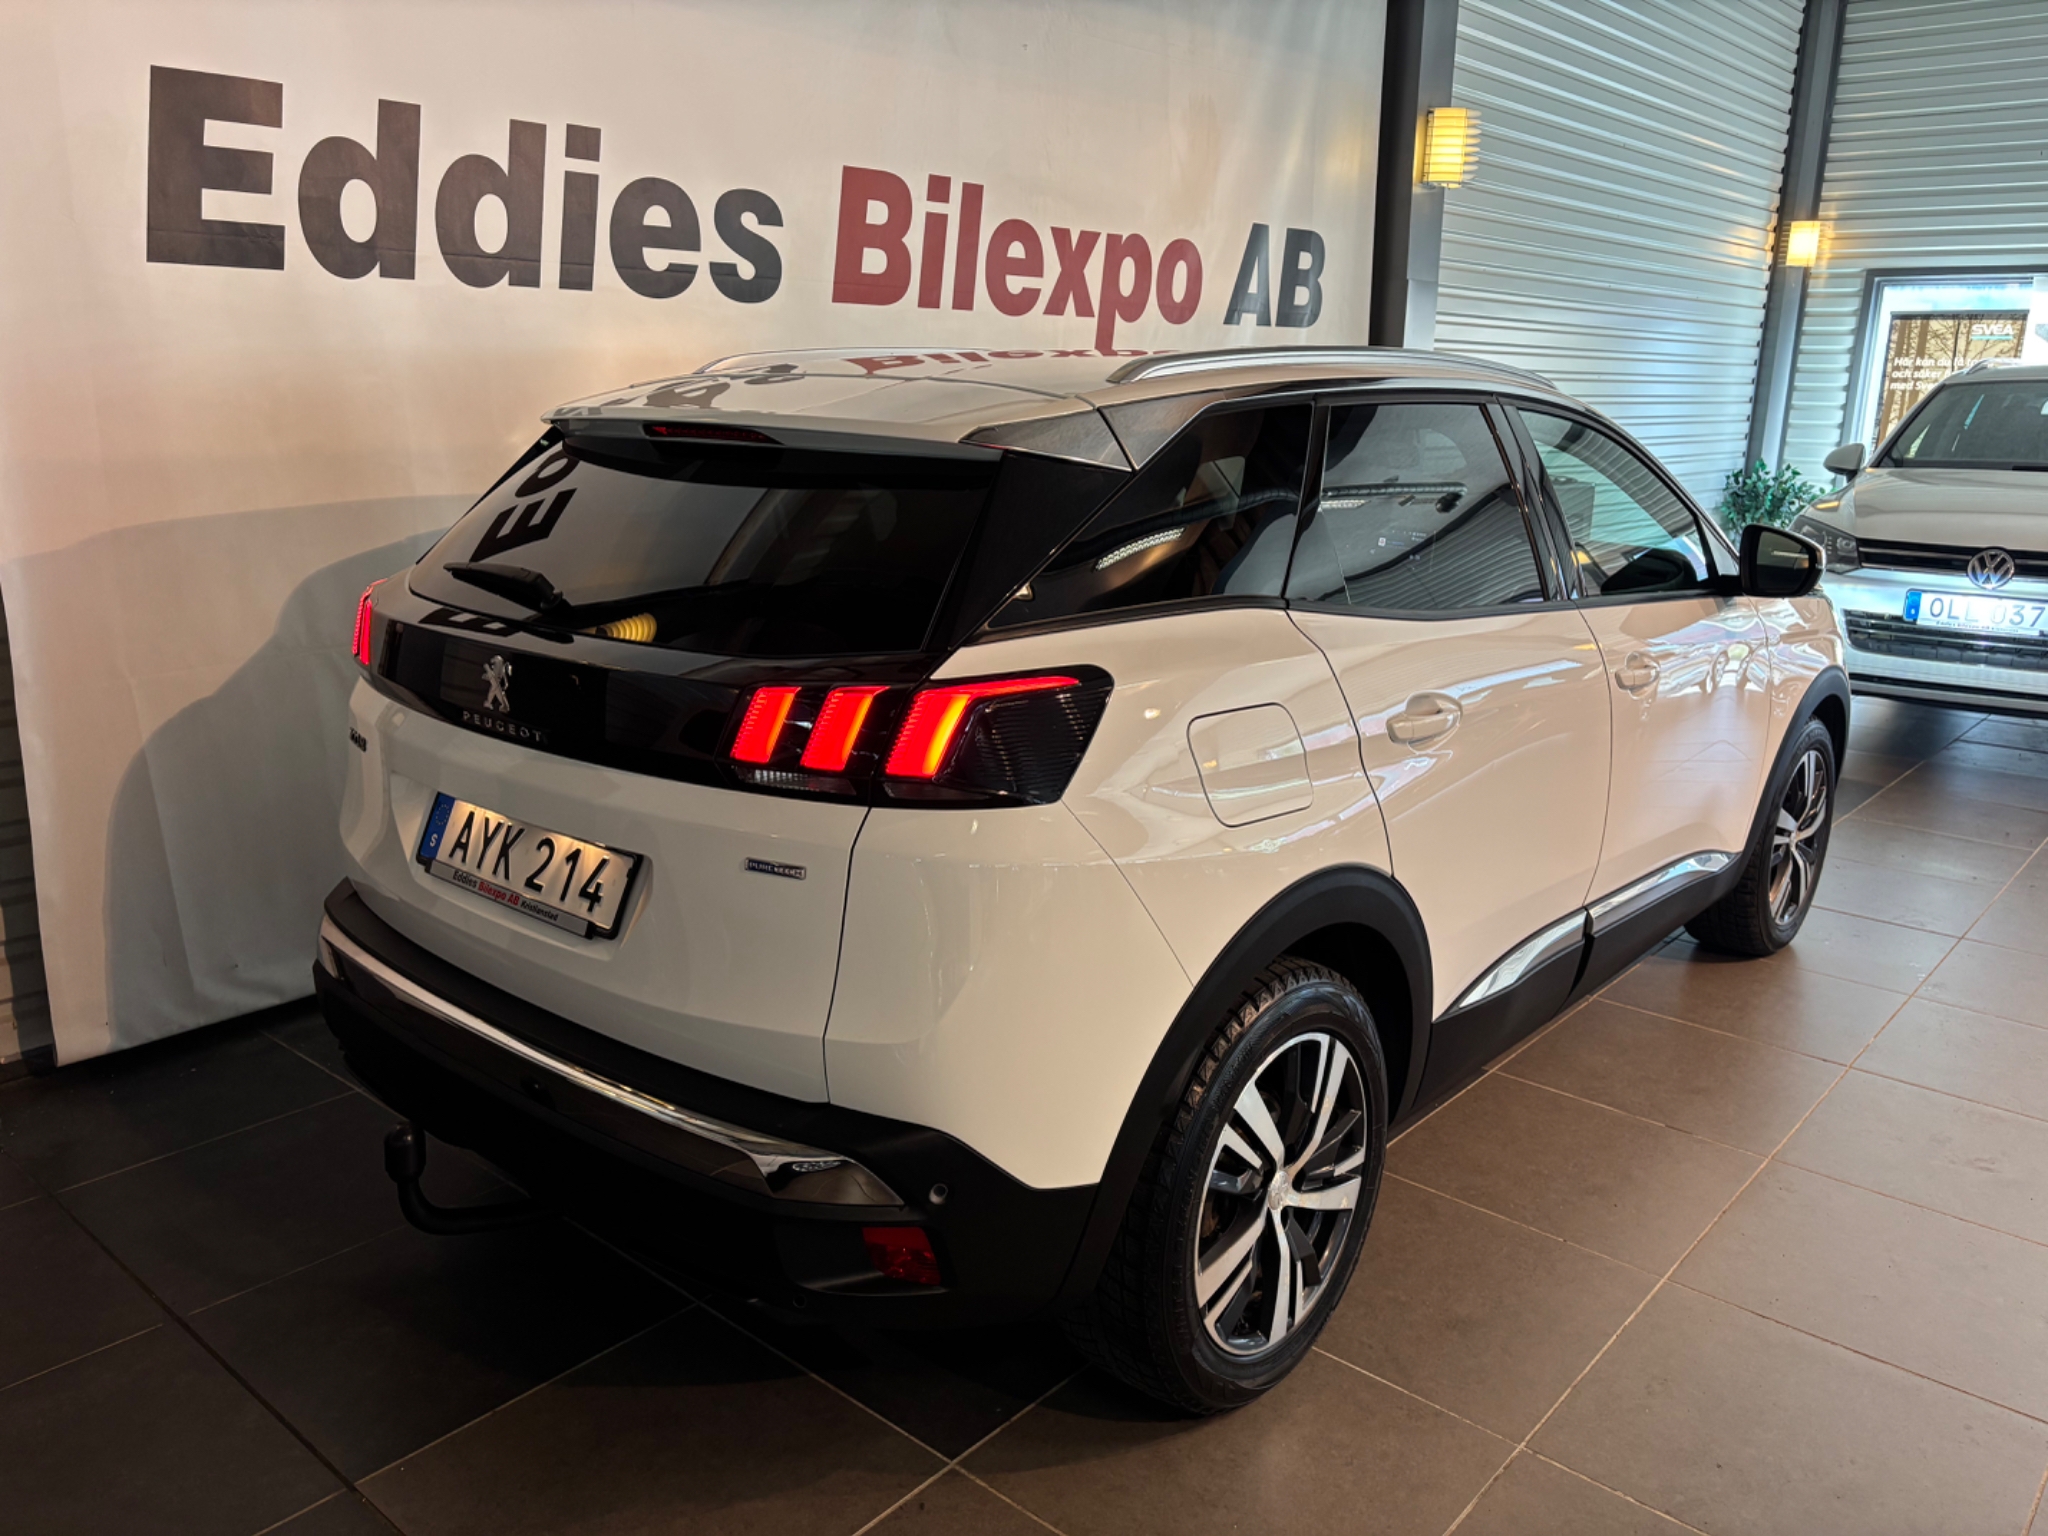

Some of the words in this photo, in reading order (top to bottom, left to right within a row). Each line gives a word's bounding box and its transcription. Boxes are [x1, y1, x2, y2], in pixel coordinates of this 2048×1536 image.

[147, 64, 784, 304] Eddies
[831, 165, 1203, 350] Bilexpo
[1223, 222, 1326, 328] AB
[1971, 323, 2014, 335] SVEA
[1916, 356, 1935, 366] kan
[1937, 356, 1951, 366] du
[1891, 369, 1912, 378] och
[1890, 380, 1914, 390] med
[1929, 597, 1979, 622] OLL
[1990, 604, 2046, 627] 037
[462, 710, 542, 742] PEUGEOT
[429, 833, 439, 848] S
[449, 810, 525, 881] AYK
[524, 837, 610, 914] 214
[452, 869, 478, 889] Eddies
[477, 881, 507, 901] Bilexpo
[507, 893, 521, 907] AB
